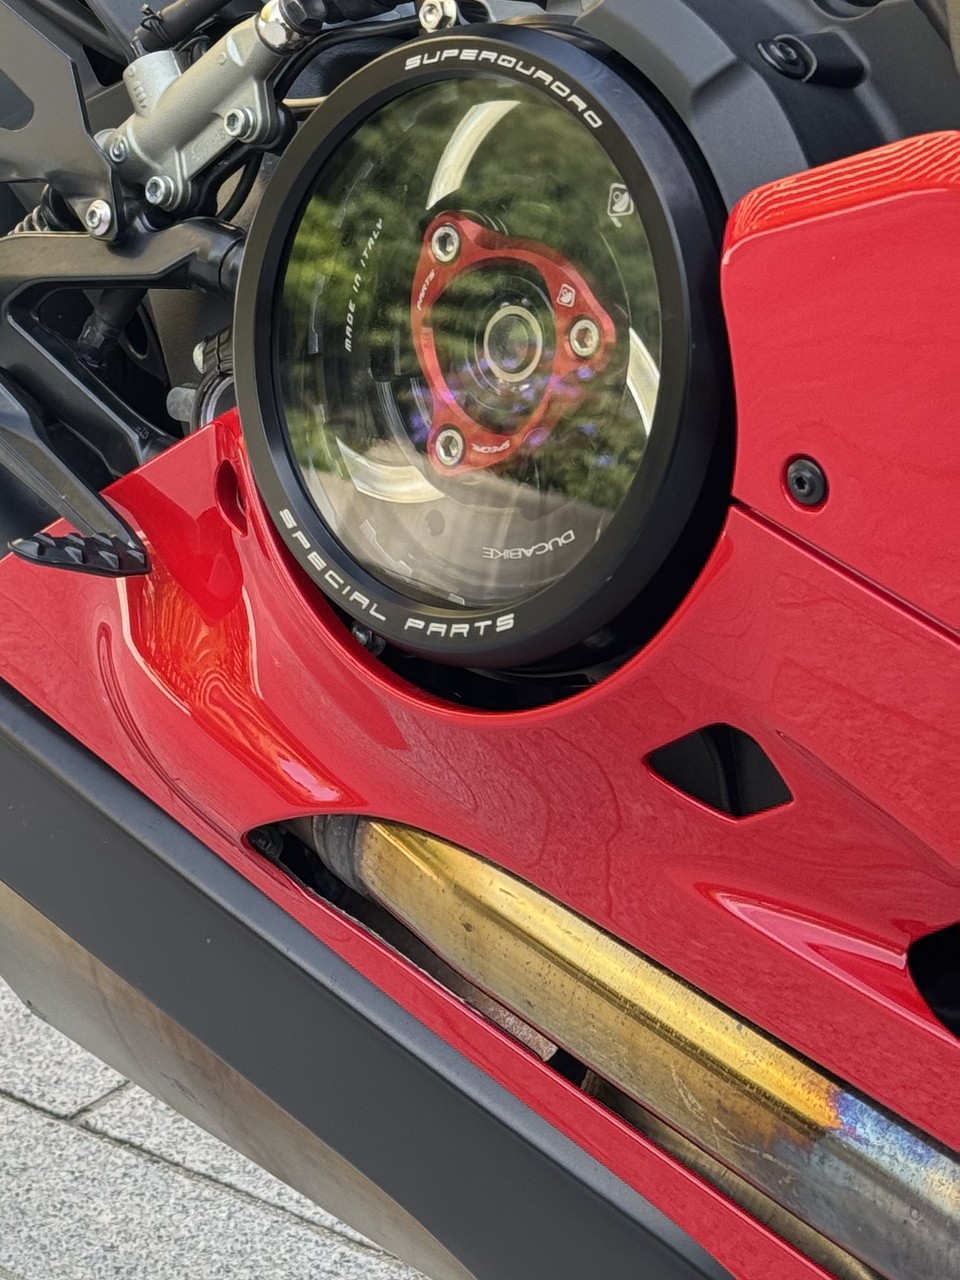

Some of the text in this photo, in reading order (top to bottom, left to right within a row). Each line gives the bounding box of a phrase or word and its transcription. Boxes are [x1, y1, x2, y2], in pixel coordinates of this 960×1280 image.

[404, 48, 604, 129] SUPERQUADRO
[344, 217, 383, 353] MADE IN ITALY
[279, 508, 516, 639] SPECIAL PARTS
[481, 528, 577, 561] DUCABIKE
